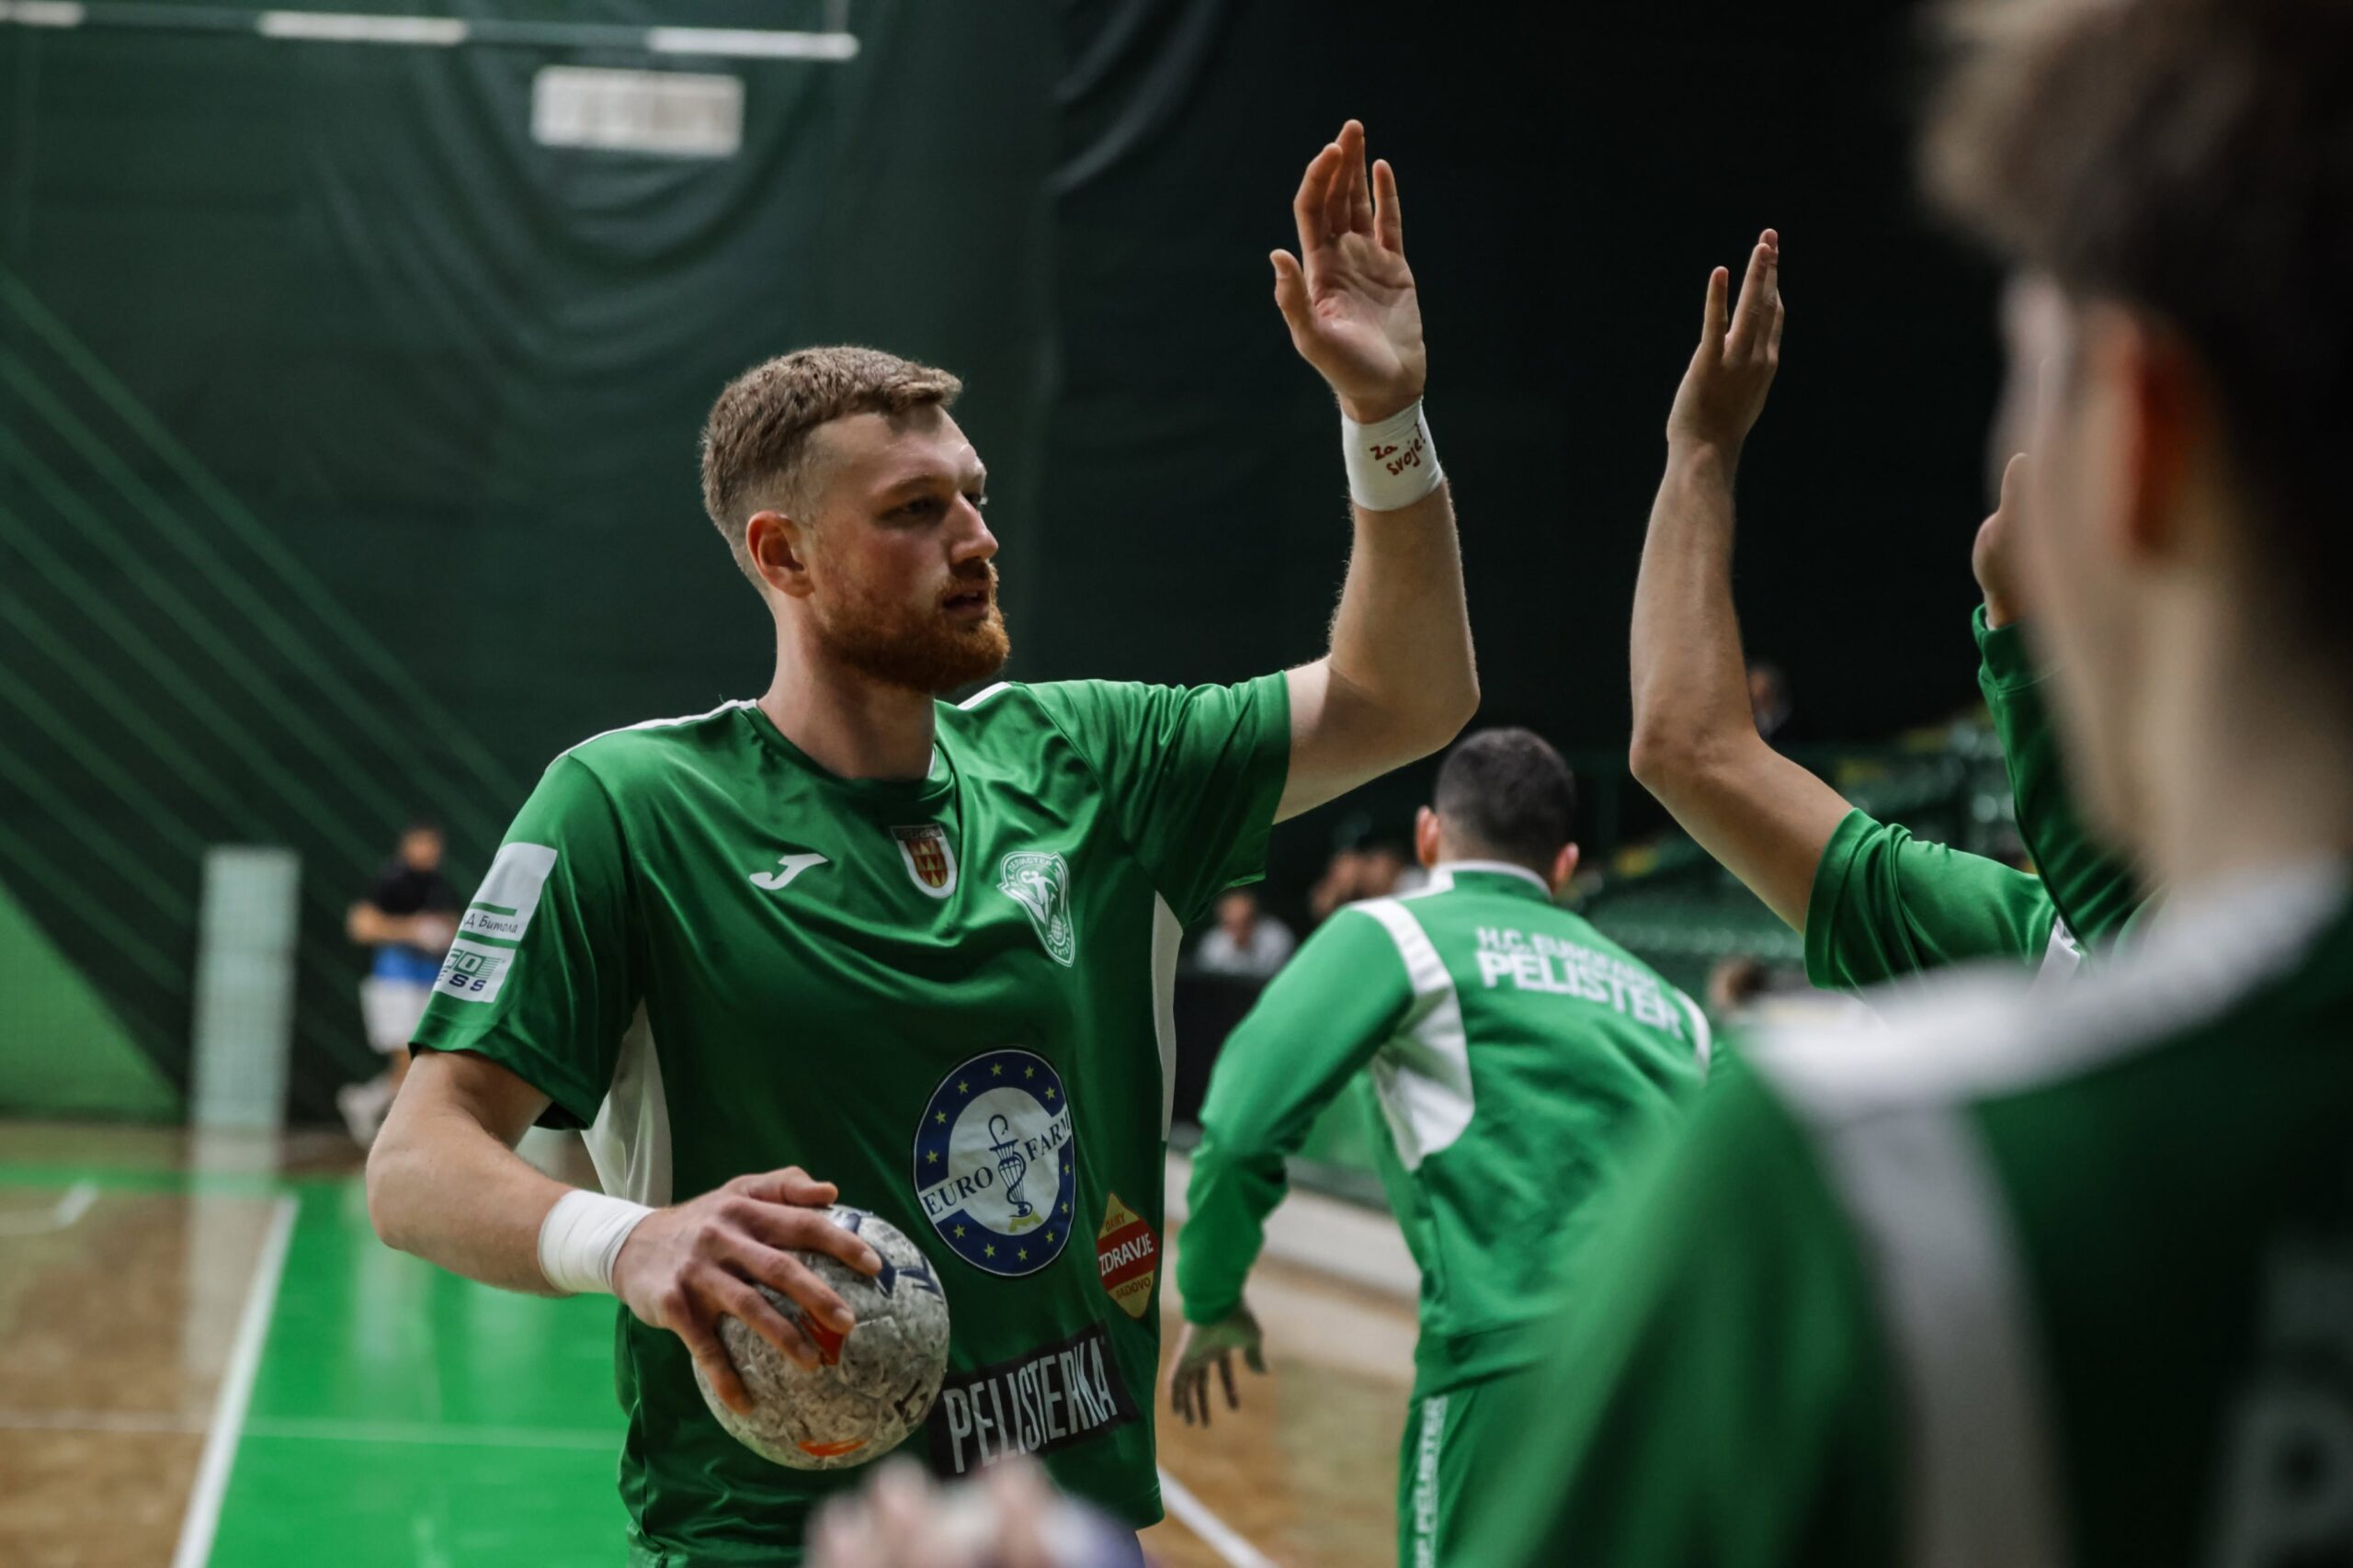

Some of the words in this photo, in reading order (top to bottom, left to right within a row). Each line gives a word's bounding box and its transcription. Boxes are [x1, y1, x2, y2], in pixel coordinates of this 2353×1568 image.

[1476, 950, 1684, 1040] PELISTER
[922, 1165, 994, 1216] EURO
[1098, 1233, 1154, 1277] ZDRAVJE
[943, 1337, 1118, 1473] PELISTERKA
